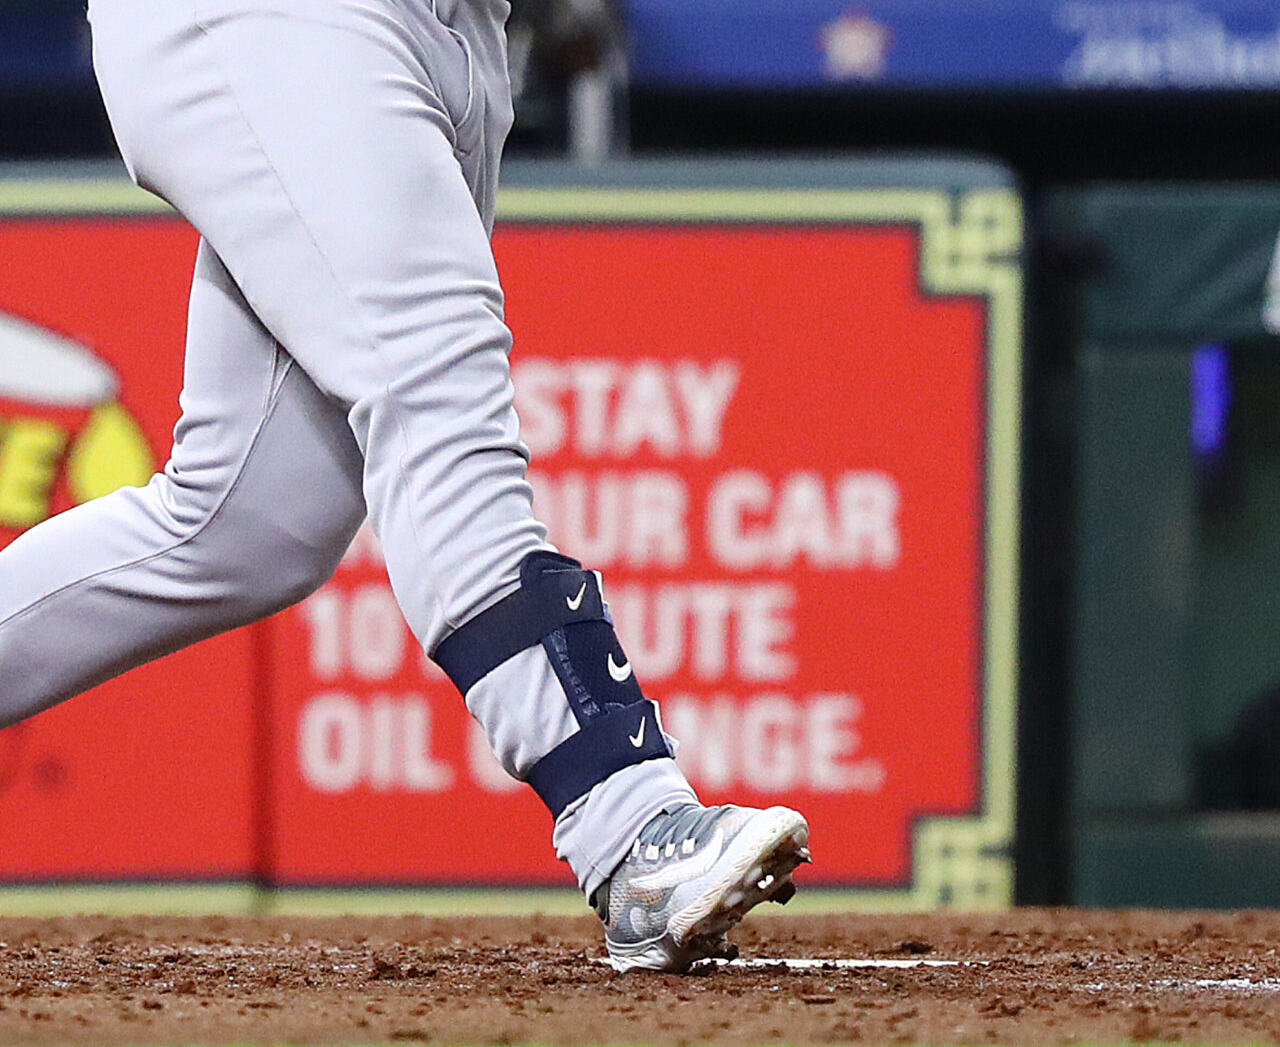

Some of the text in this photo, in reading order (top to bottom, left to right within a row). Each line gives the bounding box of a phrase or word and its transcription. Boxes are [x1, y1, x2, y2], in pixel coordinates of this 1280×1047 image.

[512, 359, 738, 458] STAY
[523, 467, 900, 571] UR CAR
[305, 583, 408, 681] 10
[297, 693, 457, 793] OIL
